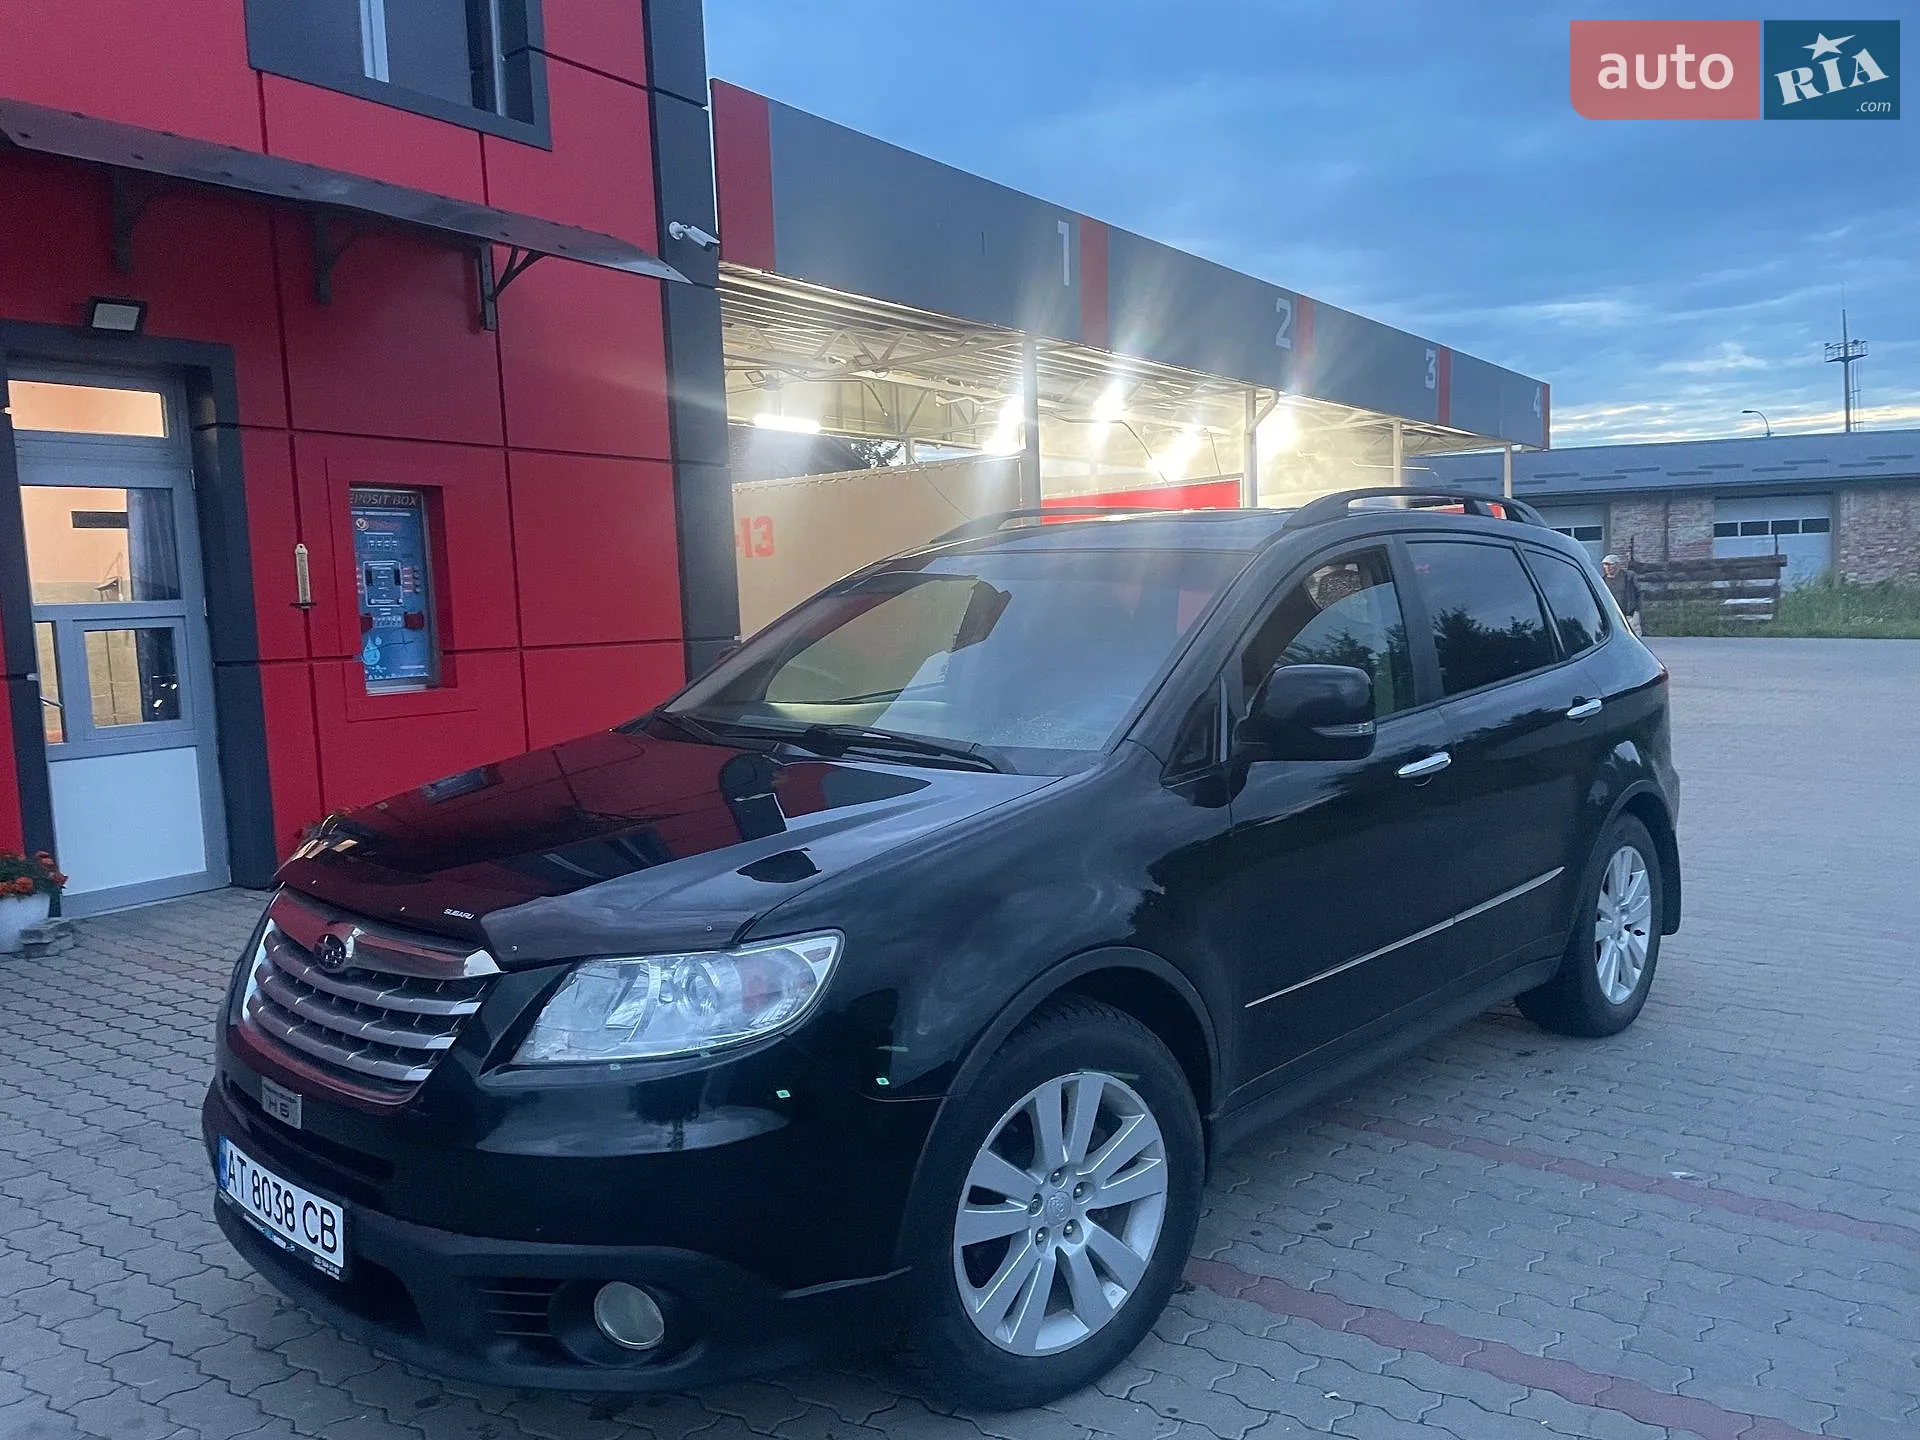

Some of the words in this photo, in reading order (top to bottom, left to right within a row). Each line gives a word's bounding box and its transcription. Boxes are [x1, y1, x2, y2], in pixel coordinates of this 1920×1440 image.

[1057, 221, 1071, 287] 1
[1275, 298, 1291, 350] 2
[1425, 348, 1437, 390] 3
[1532, 386, 1542, 419] 4
[393, 494, 417, 506] BOX
[228, 1150, 247, 1199] AT
[252, 1169, 296, 1233] 8038
[302, 1200, 337, 1254] CB
